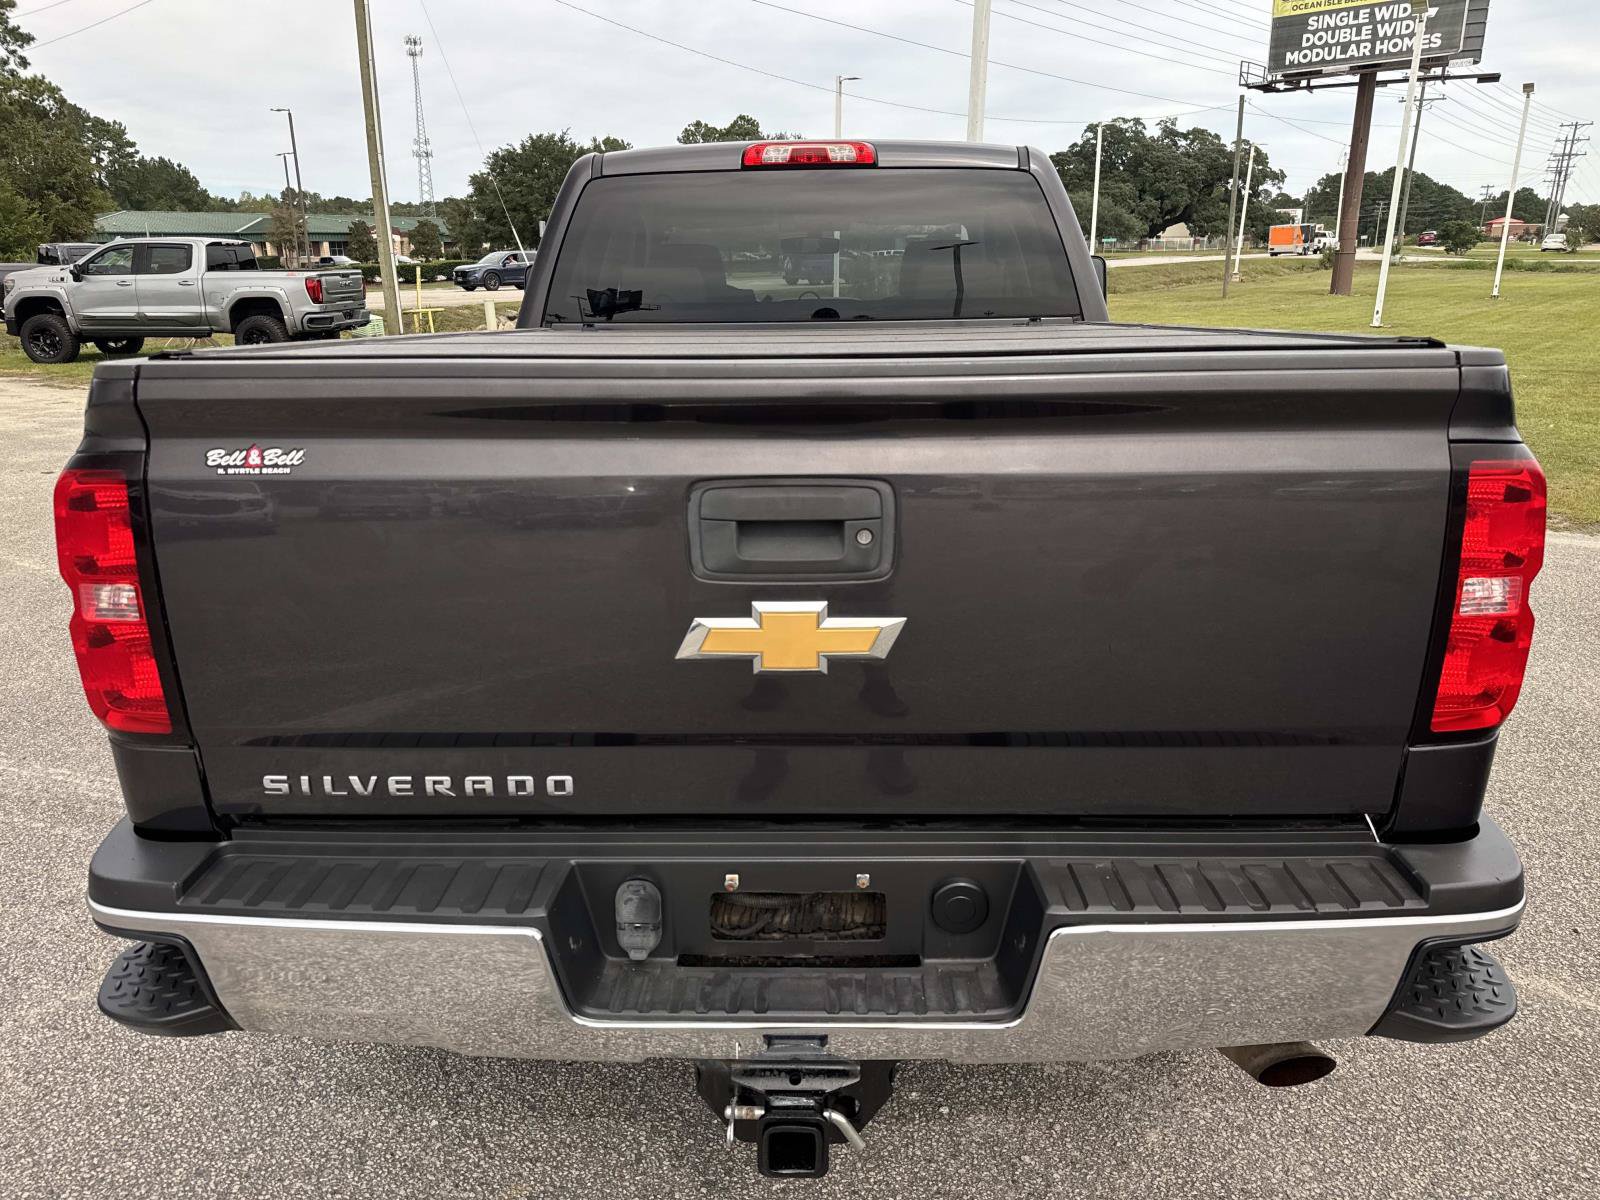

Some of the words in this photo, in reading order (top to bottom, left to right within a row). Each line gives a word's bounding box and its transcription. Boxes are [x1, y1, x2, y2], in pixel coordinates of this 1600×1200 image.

[1292, 3, 1322, 12] OCEAN
[1307, 8, 1370, 31] SINGLE
[1374, 3, 1413, 22] WID
[1301, 25, 1372, 48] DOUBLE
[1285, 42, 1371, 66] MODULAR
[1374, 33, 1442, 55] HOMES
[206, 448, 247, 466] Bell
[248, 449, 261, 465] &
[263, 448, 304, 466] Bell
[227, 467, 260, 475] MYRTLE
[262, 775, 574, 797] SILVERADO
